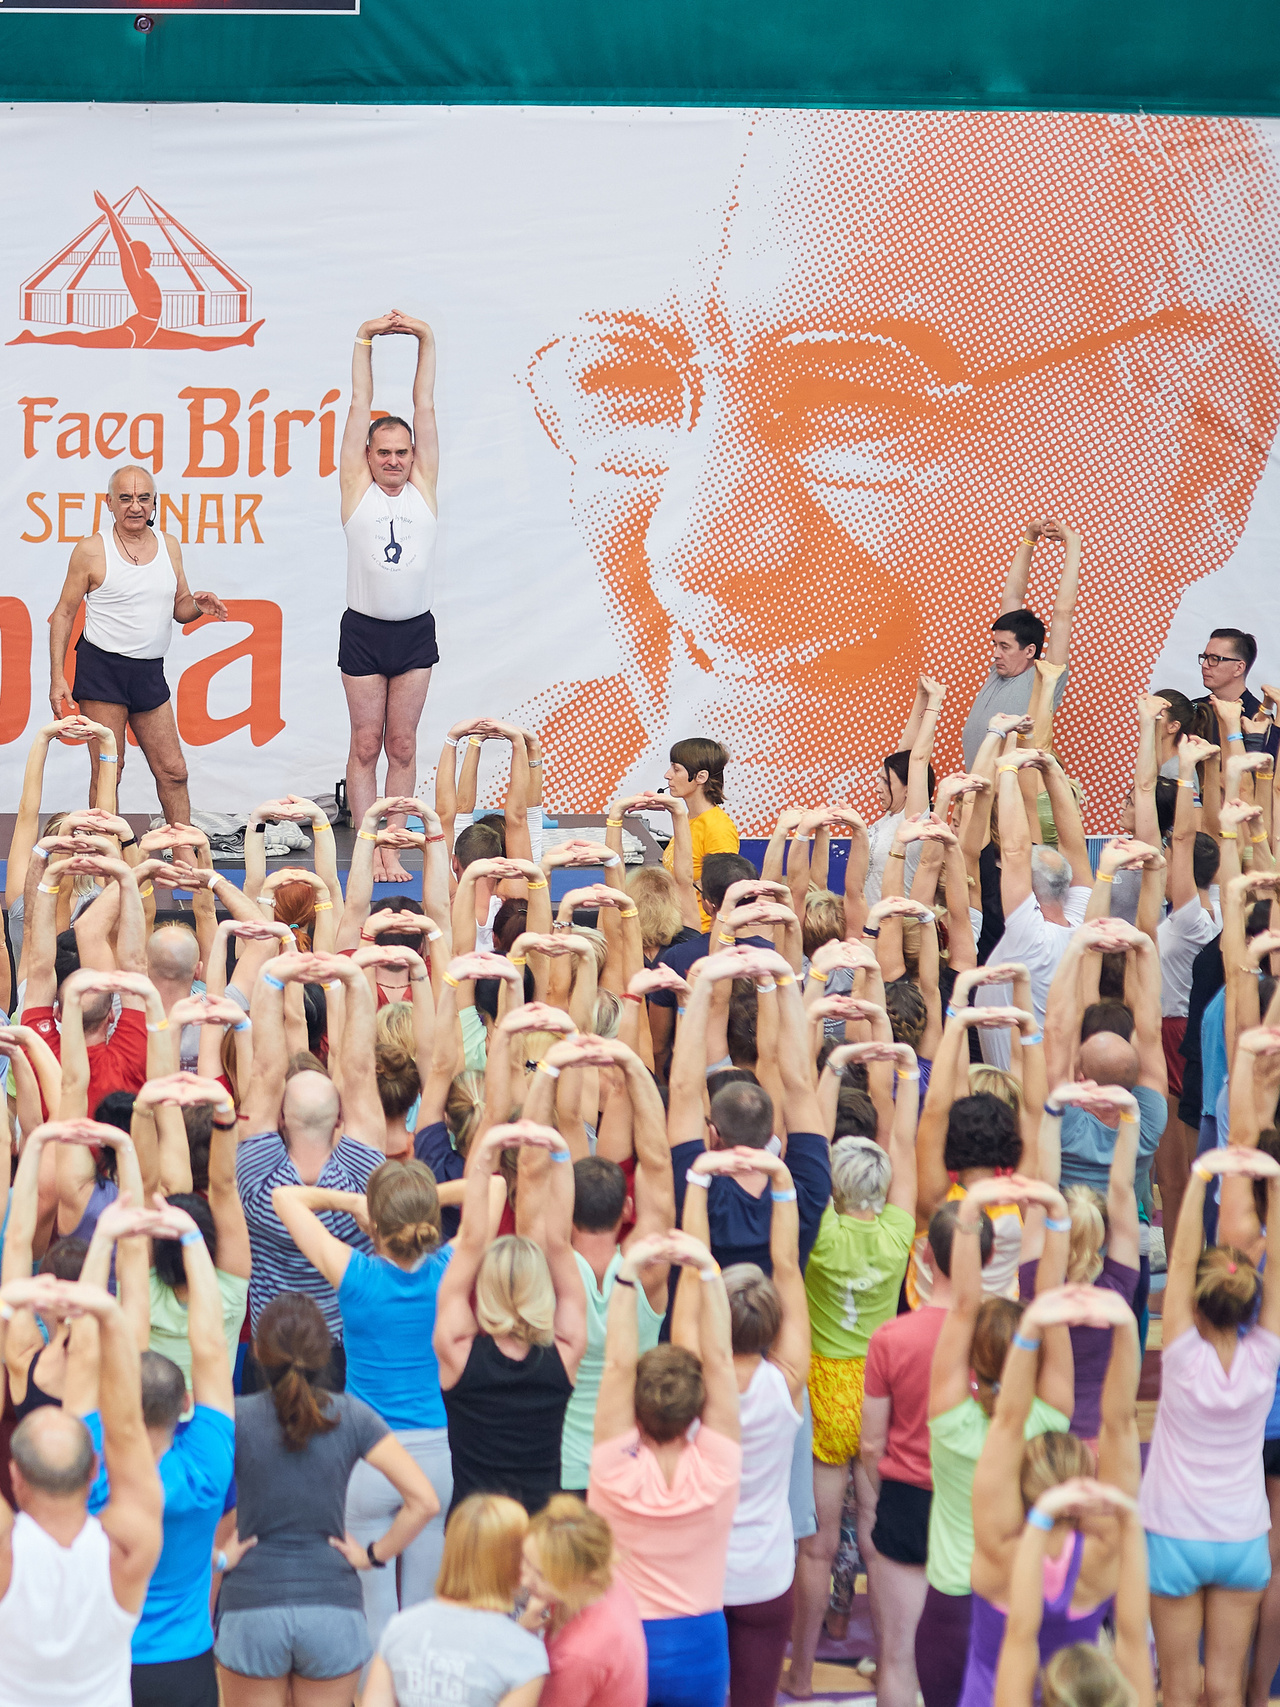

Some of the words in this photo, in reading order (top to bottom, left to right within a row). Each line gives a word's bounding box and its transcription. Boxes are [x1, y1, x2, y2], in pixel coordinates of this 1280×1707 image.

[17, 395, 163, 475] Faeq
[178, 386, 393, 479] Biri
[19, 491, 265, 545] SENAR
